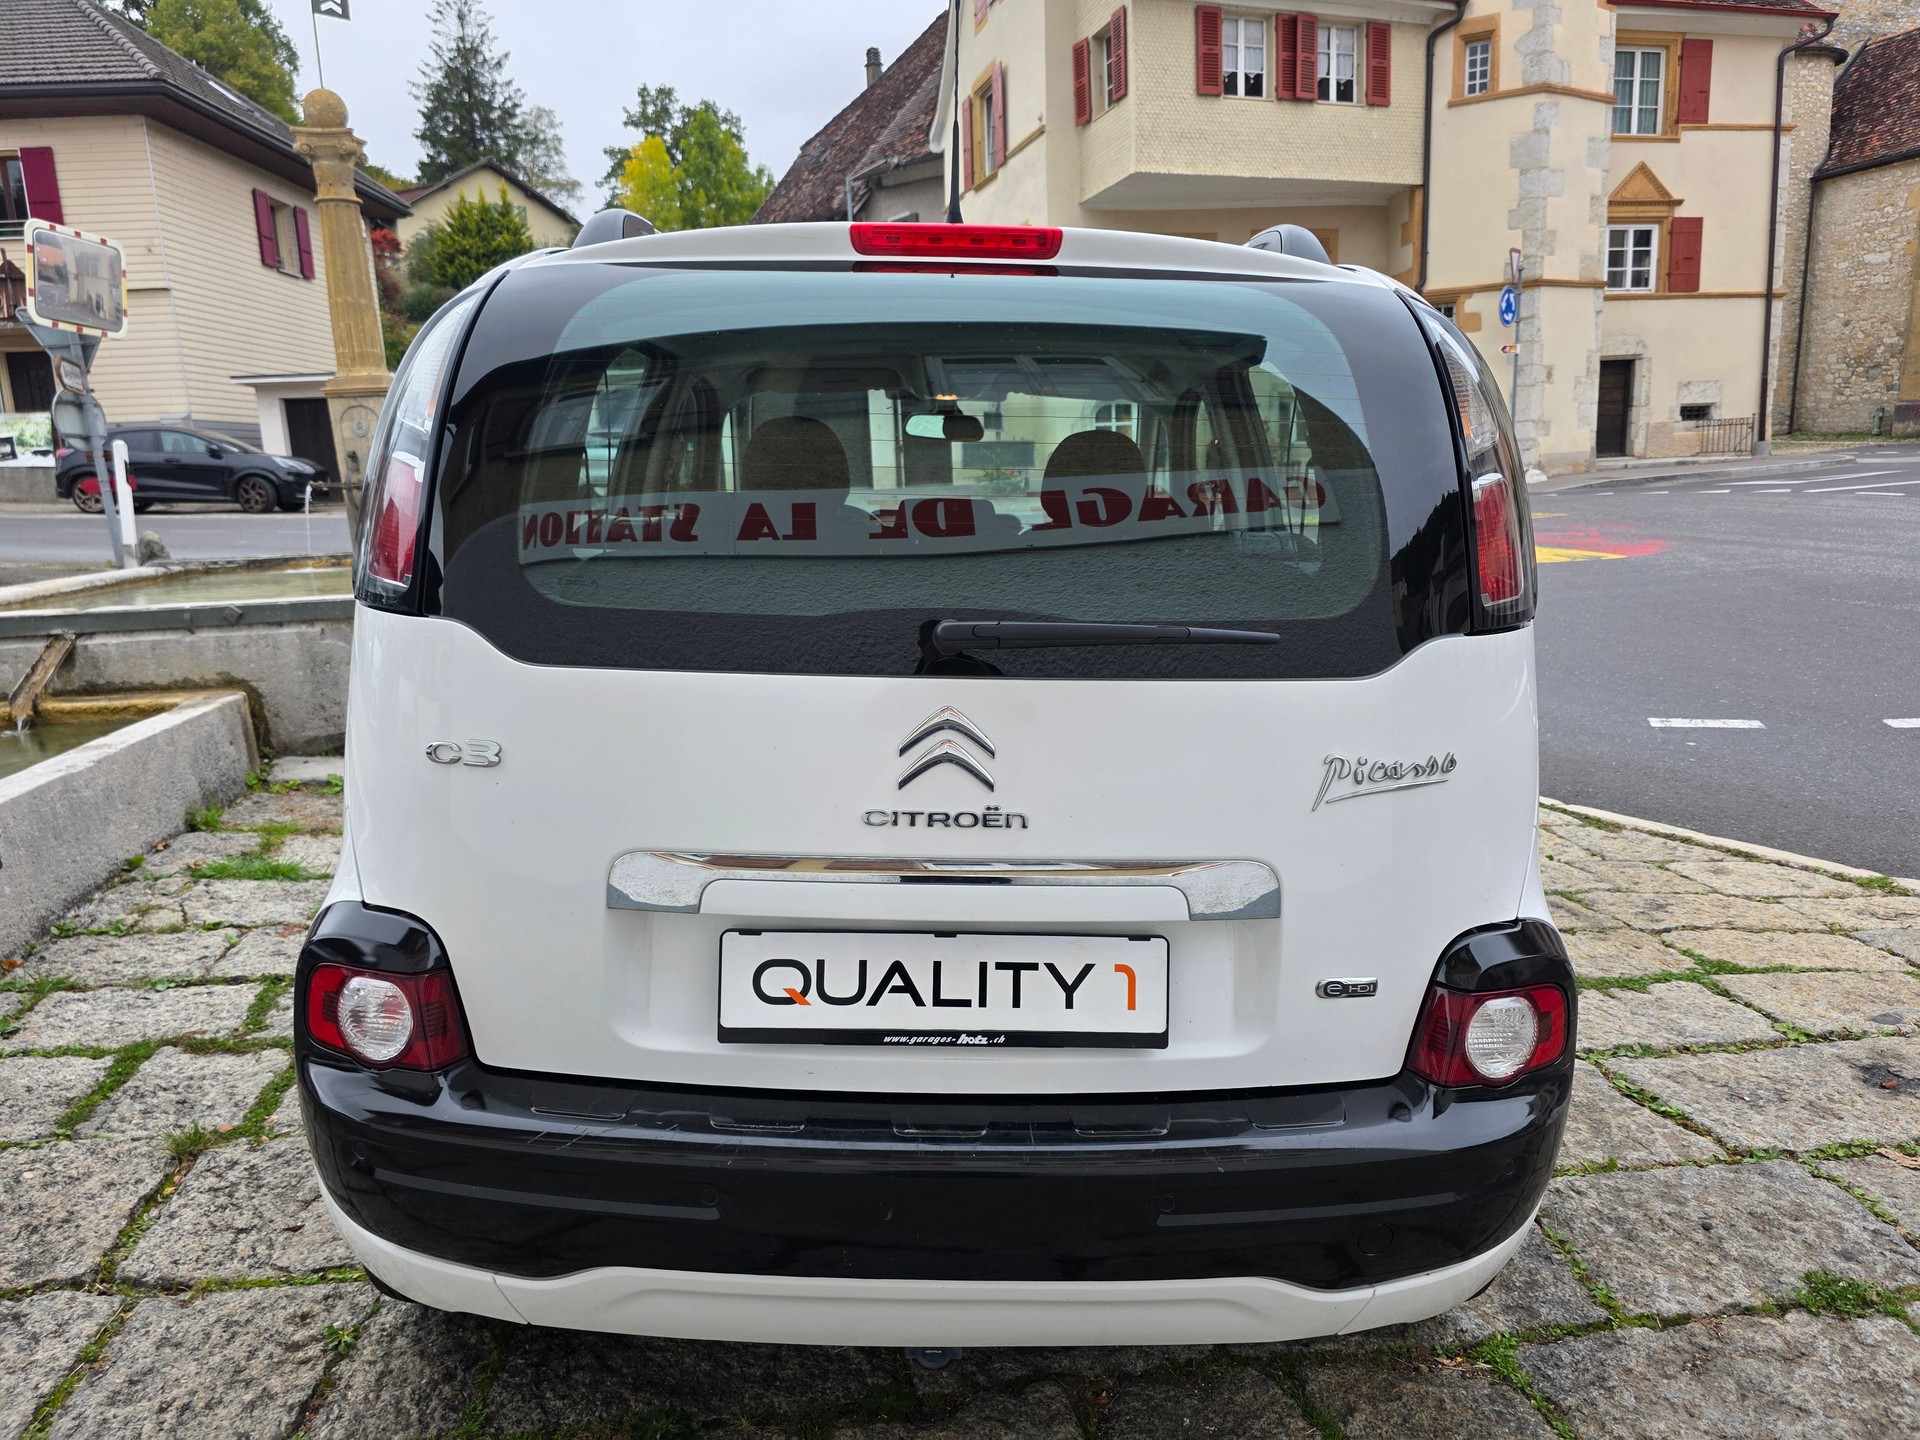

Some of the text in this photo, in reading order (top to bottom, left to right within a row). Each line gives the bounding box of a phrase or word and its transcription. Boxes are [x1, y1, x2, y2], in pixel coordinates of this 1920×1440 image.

[425, 738, 503, 768] C3
[1311, 751, 1457, 812] Picasso
[752, 958, 1137, 1011] QUALITY 1
